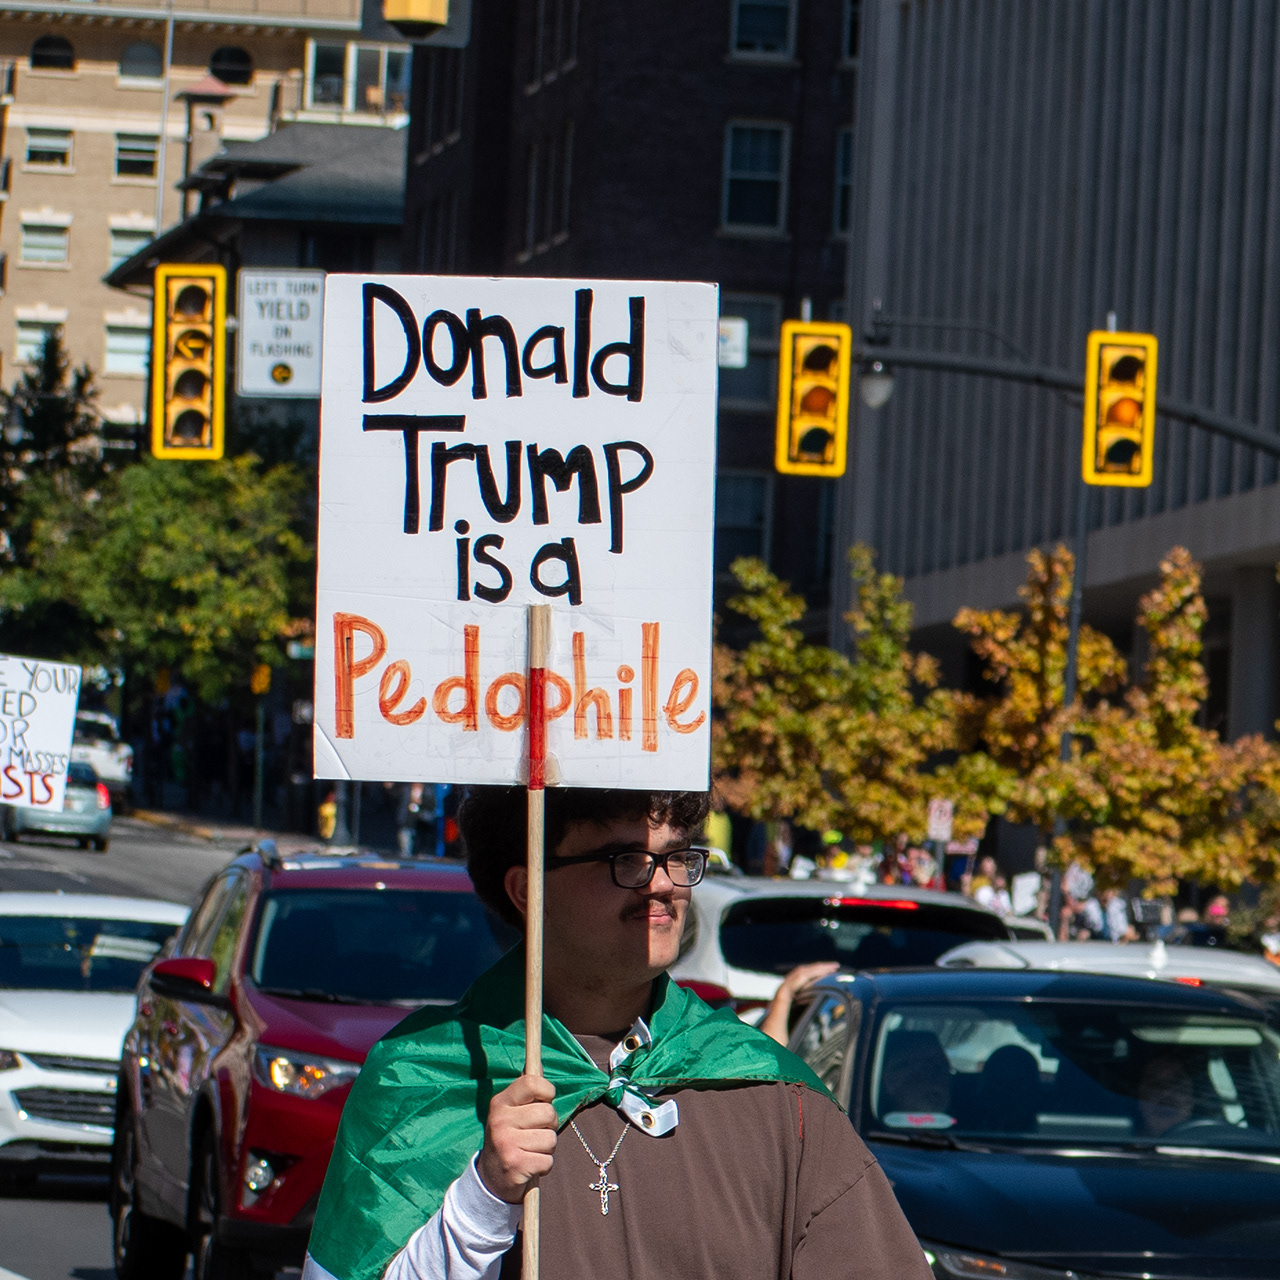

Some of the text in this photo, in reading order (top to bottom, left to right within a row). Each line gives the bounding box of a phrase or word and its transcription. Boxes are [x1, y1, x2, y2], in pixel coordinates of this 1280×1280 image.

[247, 281, 319, 295] LEFT TURN
[256, 299, 310, 320] YIELD
[251, 342, 313, 357] FLASHING
[362, 282, 645, 404] Donald
[362, 414, 654, 554] Trump
[454, 519, 583, 606] is a
[22, 661, 78, 695] YOUR
[333, 611, 707, 752] Pedophile
[9, 747, 68, 775] MASSES
